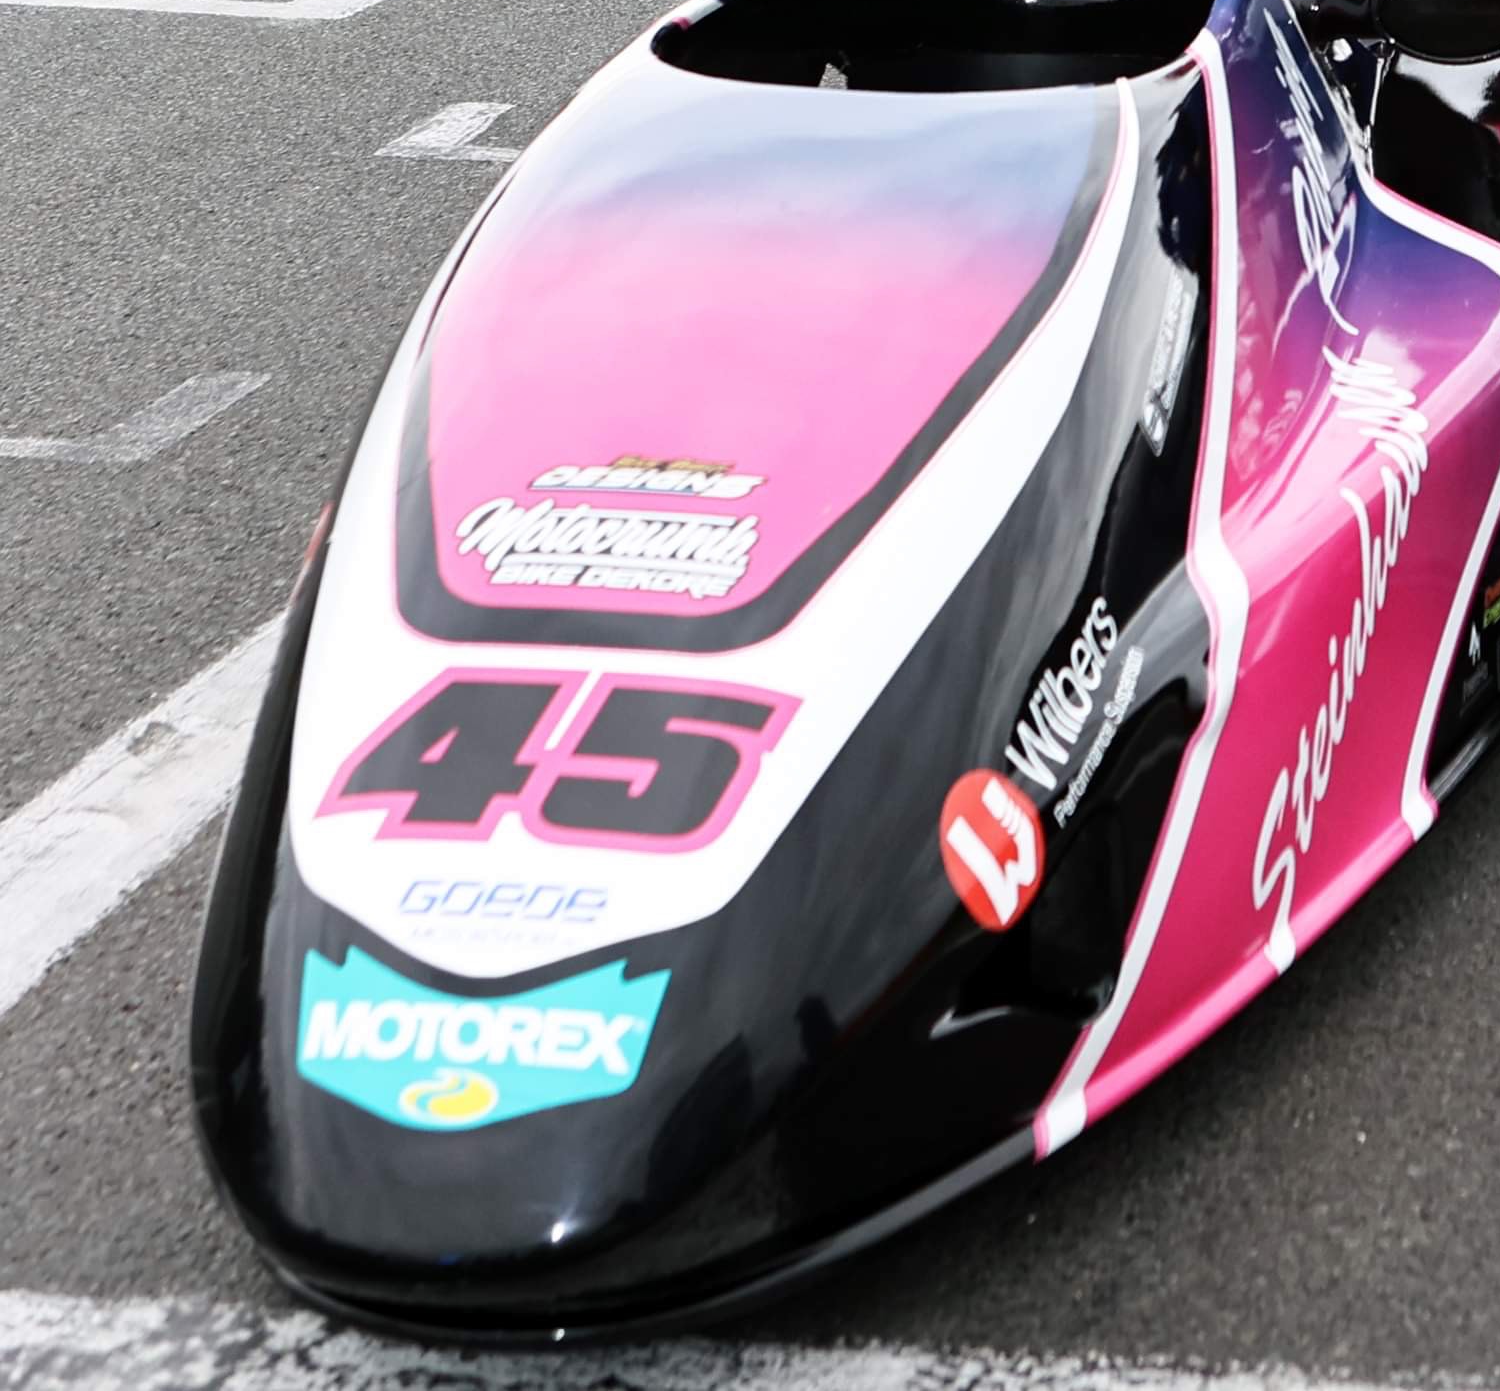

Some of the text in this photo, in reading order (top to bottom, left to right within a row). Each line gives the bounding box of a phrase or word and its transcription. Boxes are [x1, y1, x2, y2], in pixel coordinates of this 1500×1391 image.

[528, 465, 770, 498] DESIGNS
[1004, 595, 1119, 791] Wilbers
[318, 669, 800, 853] 45
[302, 1000, 632, 1076] MOTOREX
